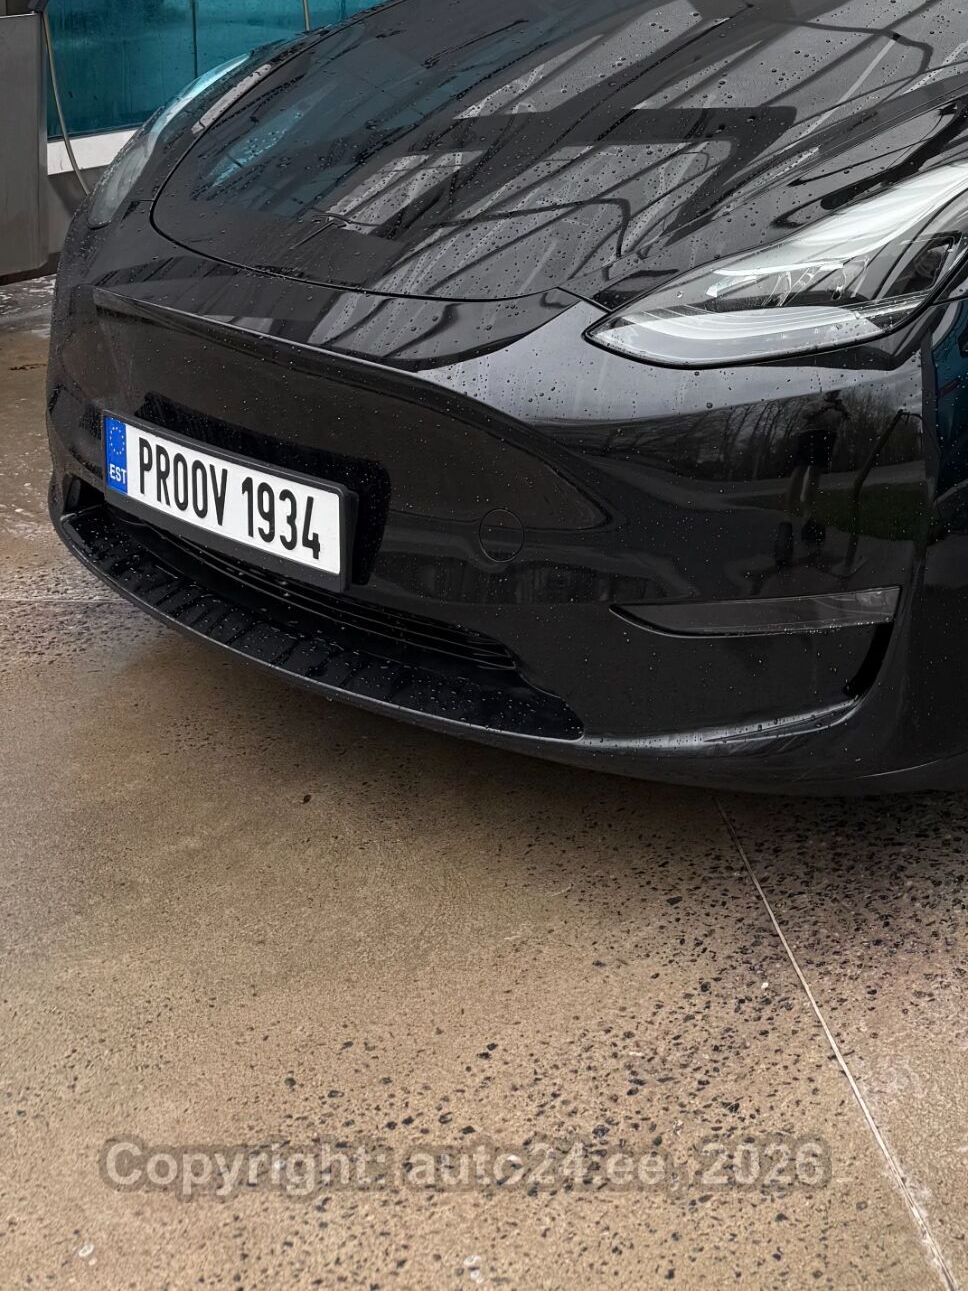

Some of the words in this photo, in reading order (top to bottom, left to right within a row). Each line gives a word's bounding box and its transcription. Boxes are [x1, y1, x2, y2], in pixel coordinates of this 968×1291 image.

[109, 464, 127, 484] EST
[139, 436, 228, 526] PROOV
[242, 476, 320, 560] 1934
